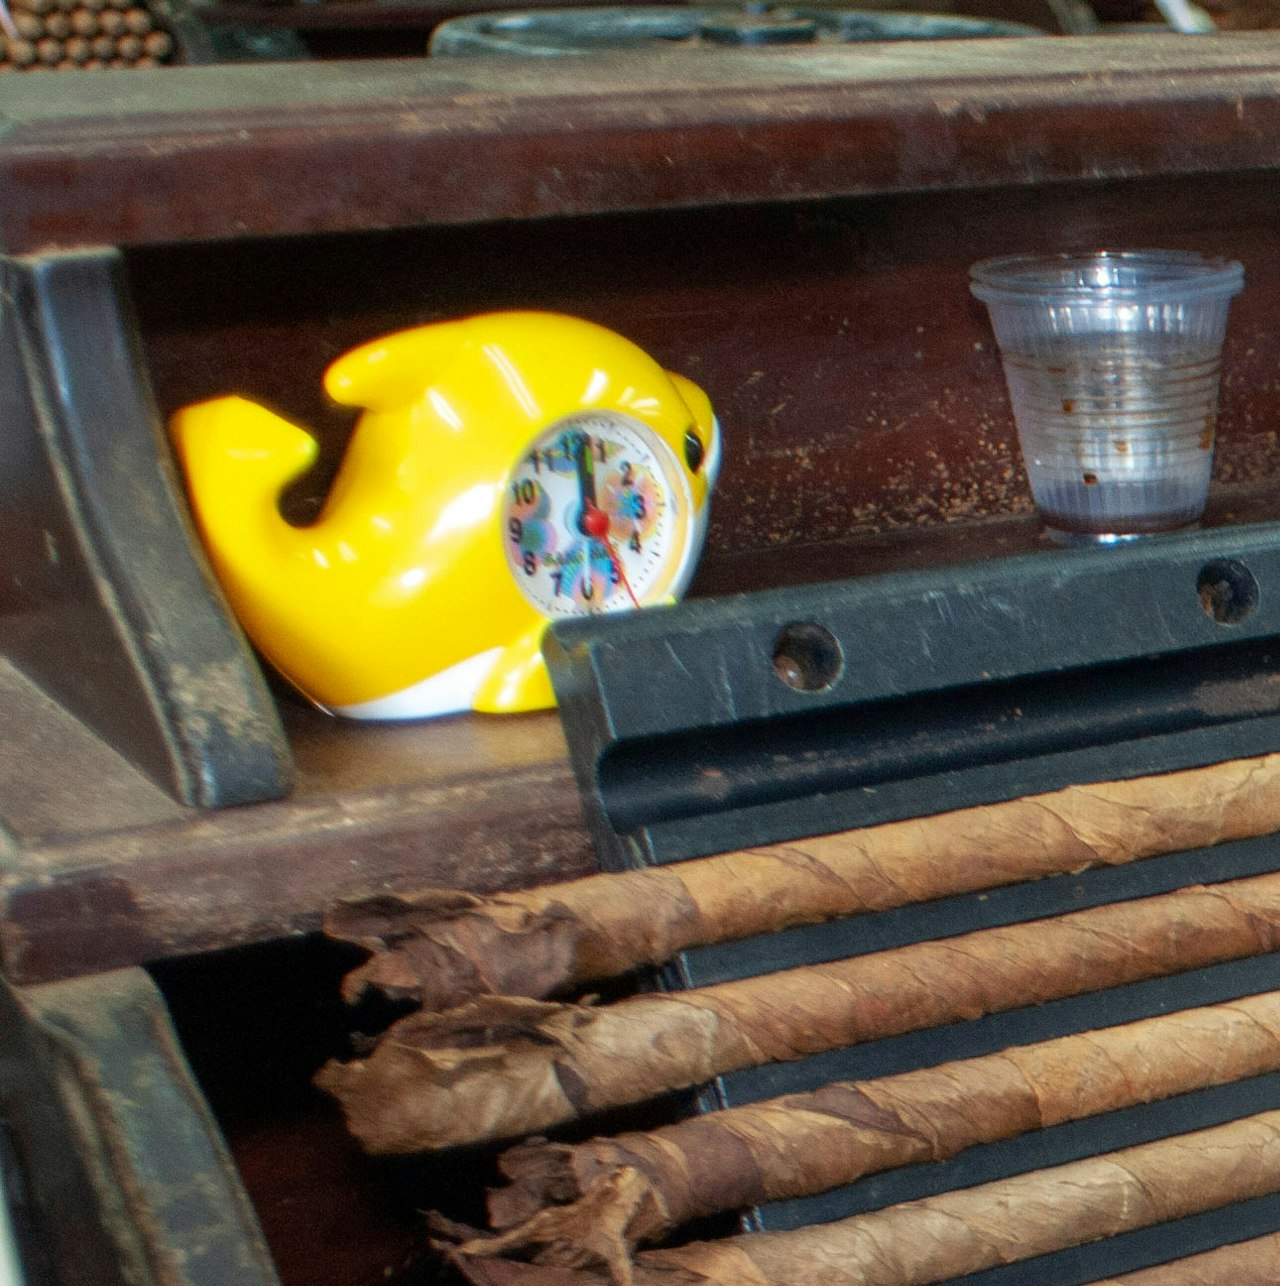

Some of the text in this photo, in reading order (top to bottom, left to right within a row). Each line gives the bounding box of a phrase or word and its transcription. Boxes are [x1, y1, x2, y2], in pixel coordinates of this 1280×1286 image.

[512, 479, 537, 506] 10
[510, 517, 523, 544] 9
[523, 551, 537, 577] 8
[550, 571, 562, 597] 7
